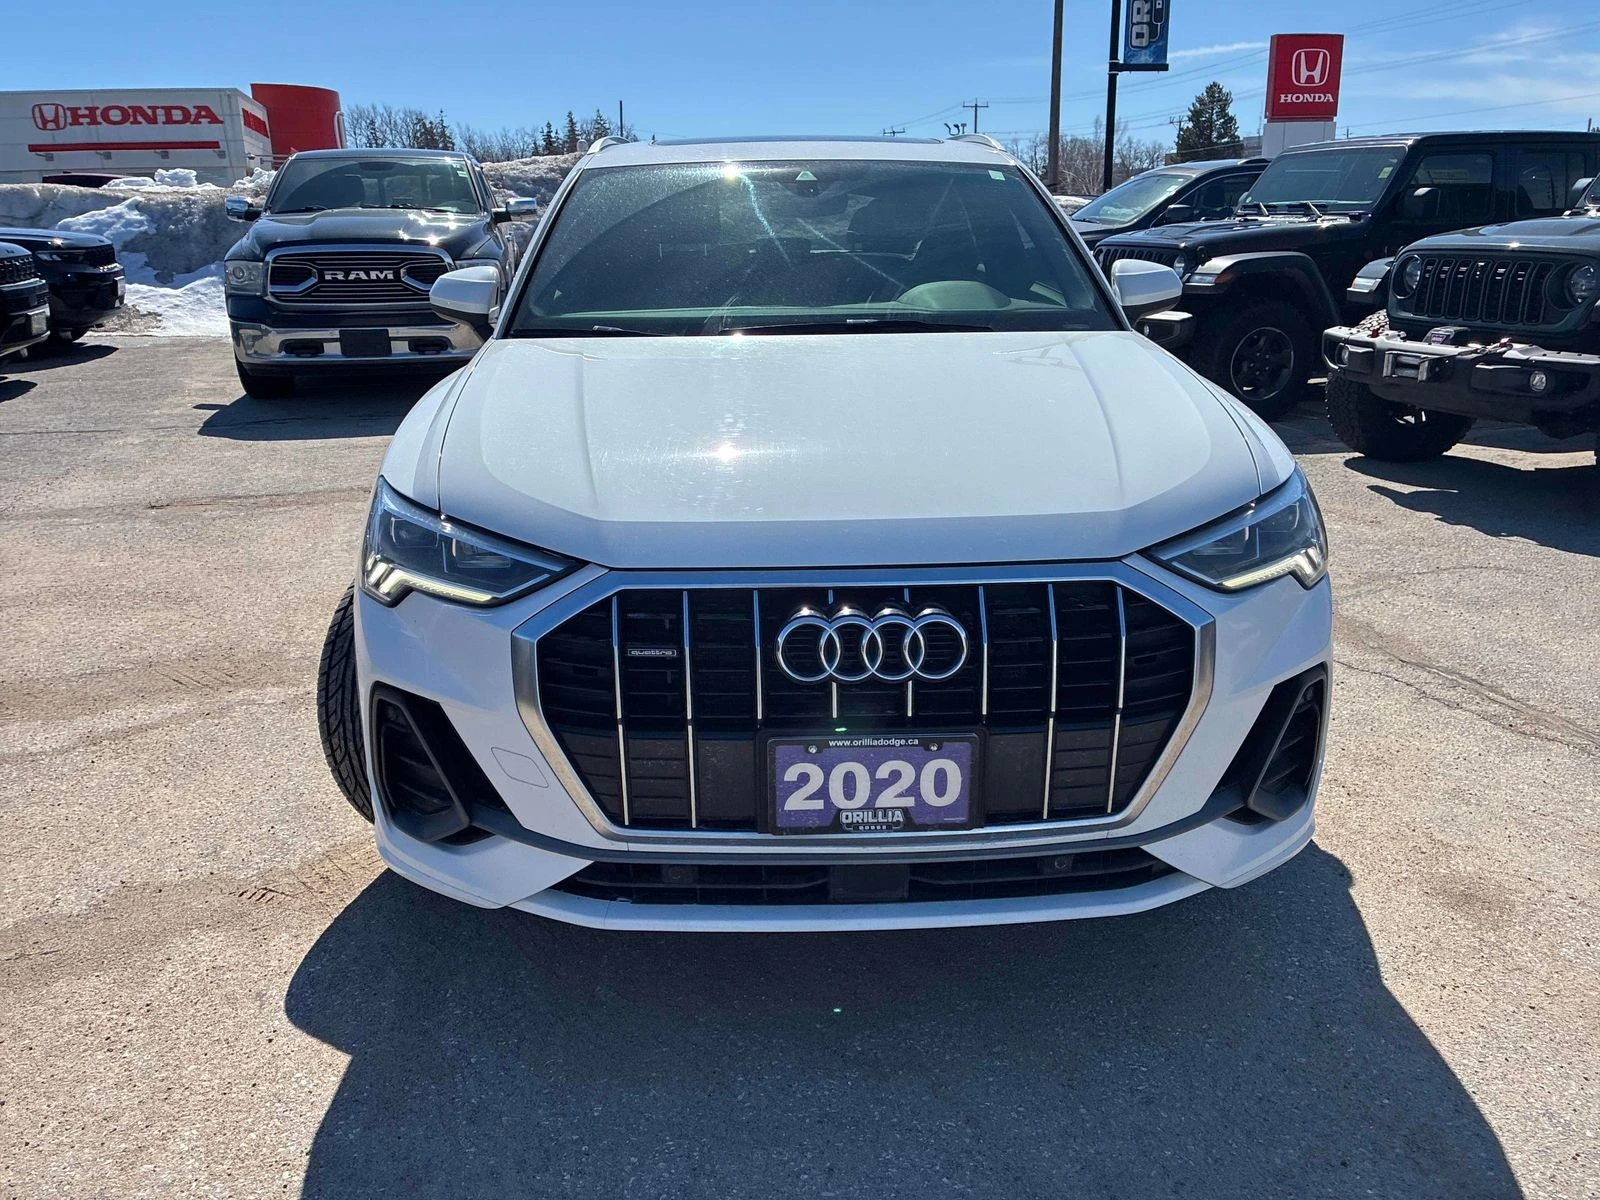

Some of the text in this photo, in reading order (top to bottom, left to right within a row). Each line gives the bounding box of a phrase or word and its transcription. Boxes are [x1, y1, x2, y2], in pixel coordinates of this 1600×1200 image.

[1279, 93, 1335, 103] HONDA
[66, 105, 224, 125] HONDA
[324, 270, 394, 280] RAM
[828, 738, 919, 746] www.orilliadodge.ca
[783, 758, 962, 810] 2020
[841, 810, 904, 824] ORILLIA
